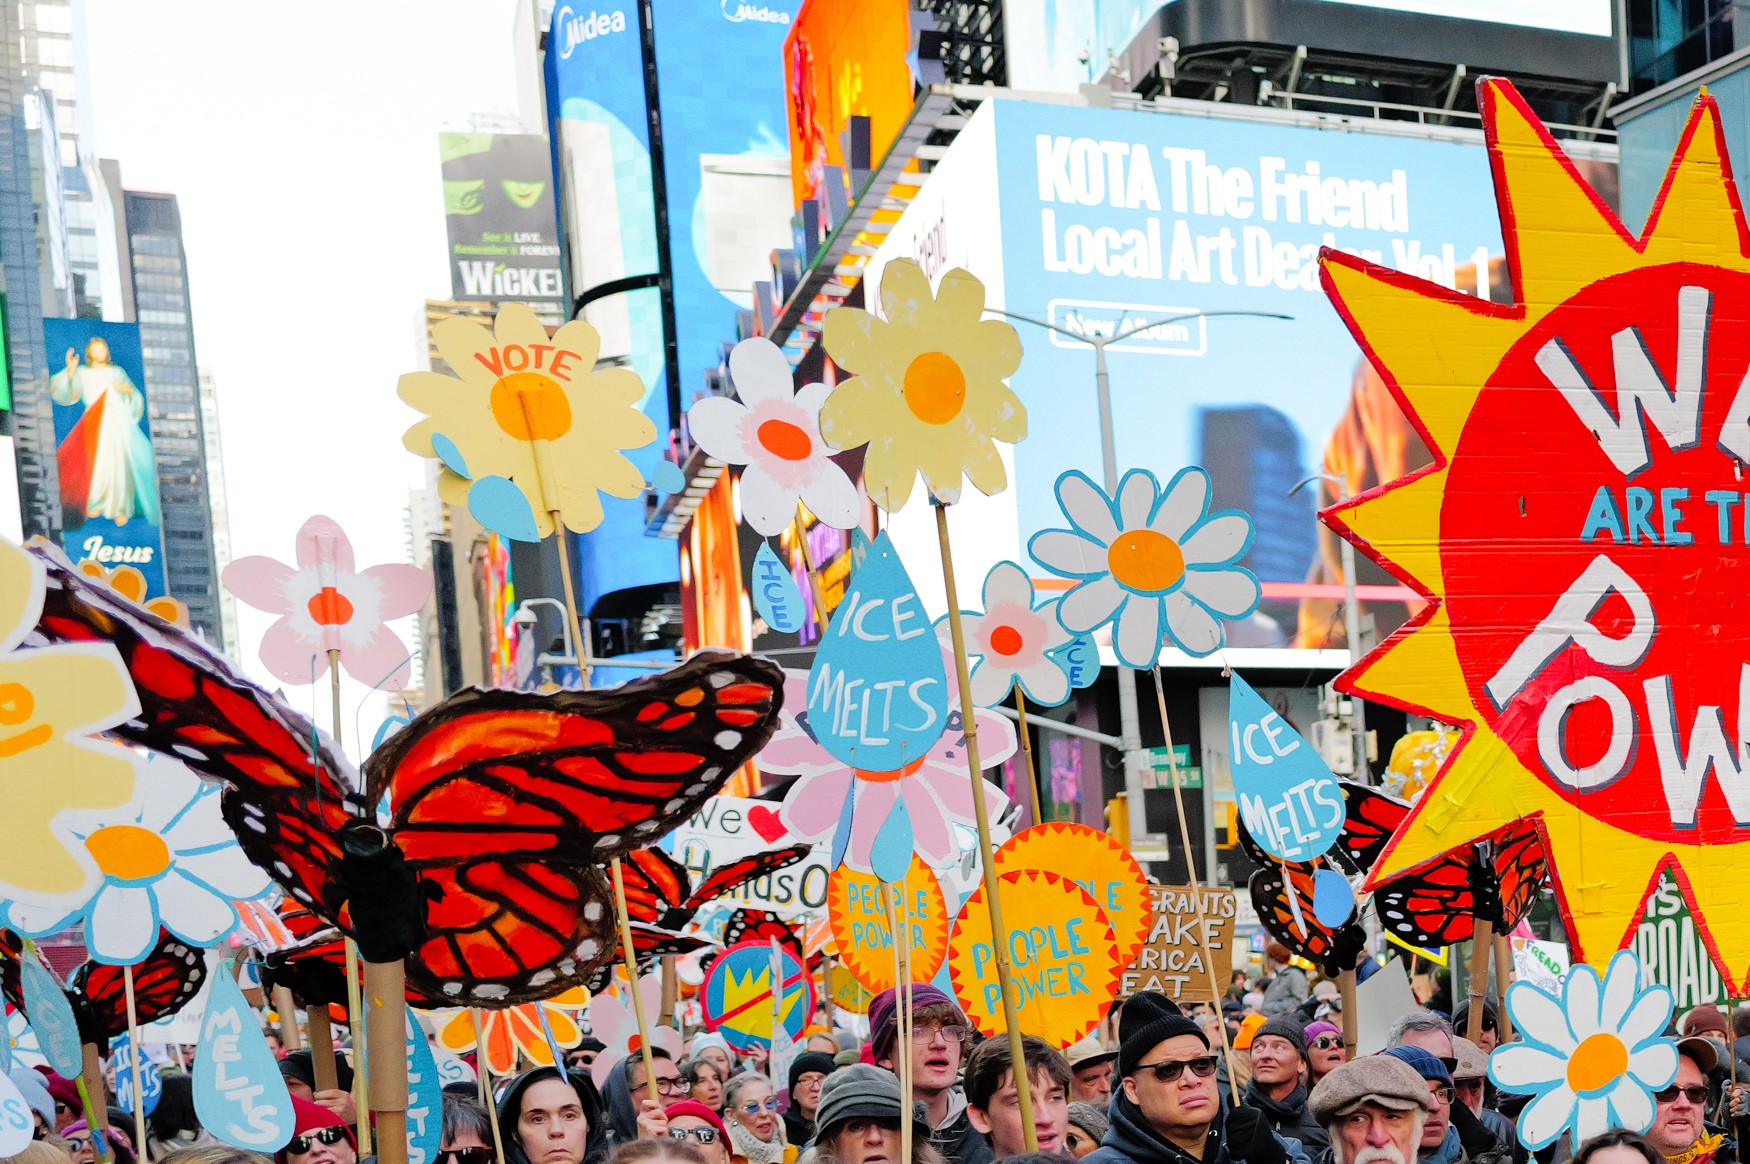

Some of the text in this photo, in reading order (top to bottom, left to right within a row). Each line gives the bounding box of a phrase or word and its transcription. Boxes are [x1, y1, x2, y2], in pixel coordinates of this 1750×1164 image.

[1035, 134, 1409, 233] KOTA The Friend
[1041, 208, 1163, 280] Local
[1168, 219, 1238, 286] Art
[473, 343, 583, 383] VOTE
[1579, 485, 1693, 548] ARE
[82, 534, 155, 564] Jesus
[758, 559, 793, 629] ICE
[838, 591, 926, 642] ICE
[808, 662, 939, 746] MELTS
[1231, 711, 1301, 765] ICE
[689, 799, 742, 835] We
[1239, 775, 1340, 858] MELTS
[971, 916, 1091, 980] POPLE
[1144, 914, 1226, 949] AKE
[205, 1005, 280, 1145] MELTS
